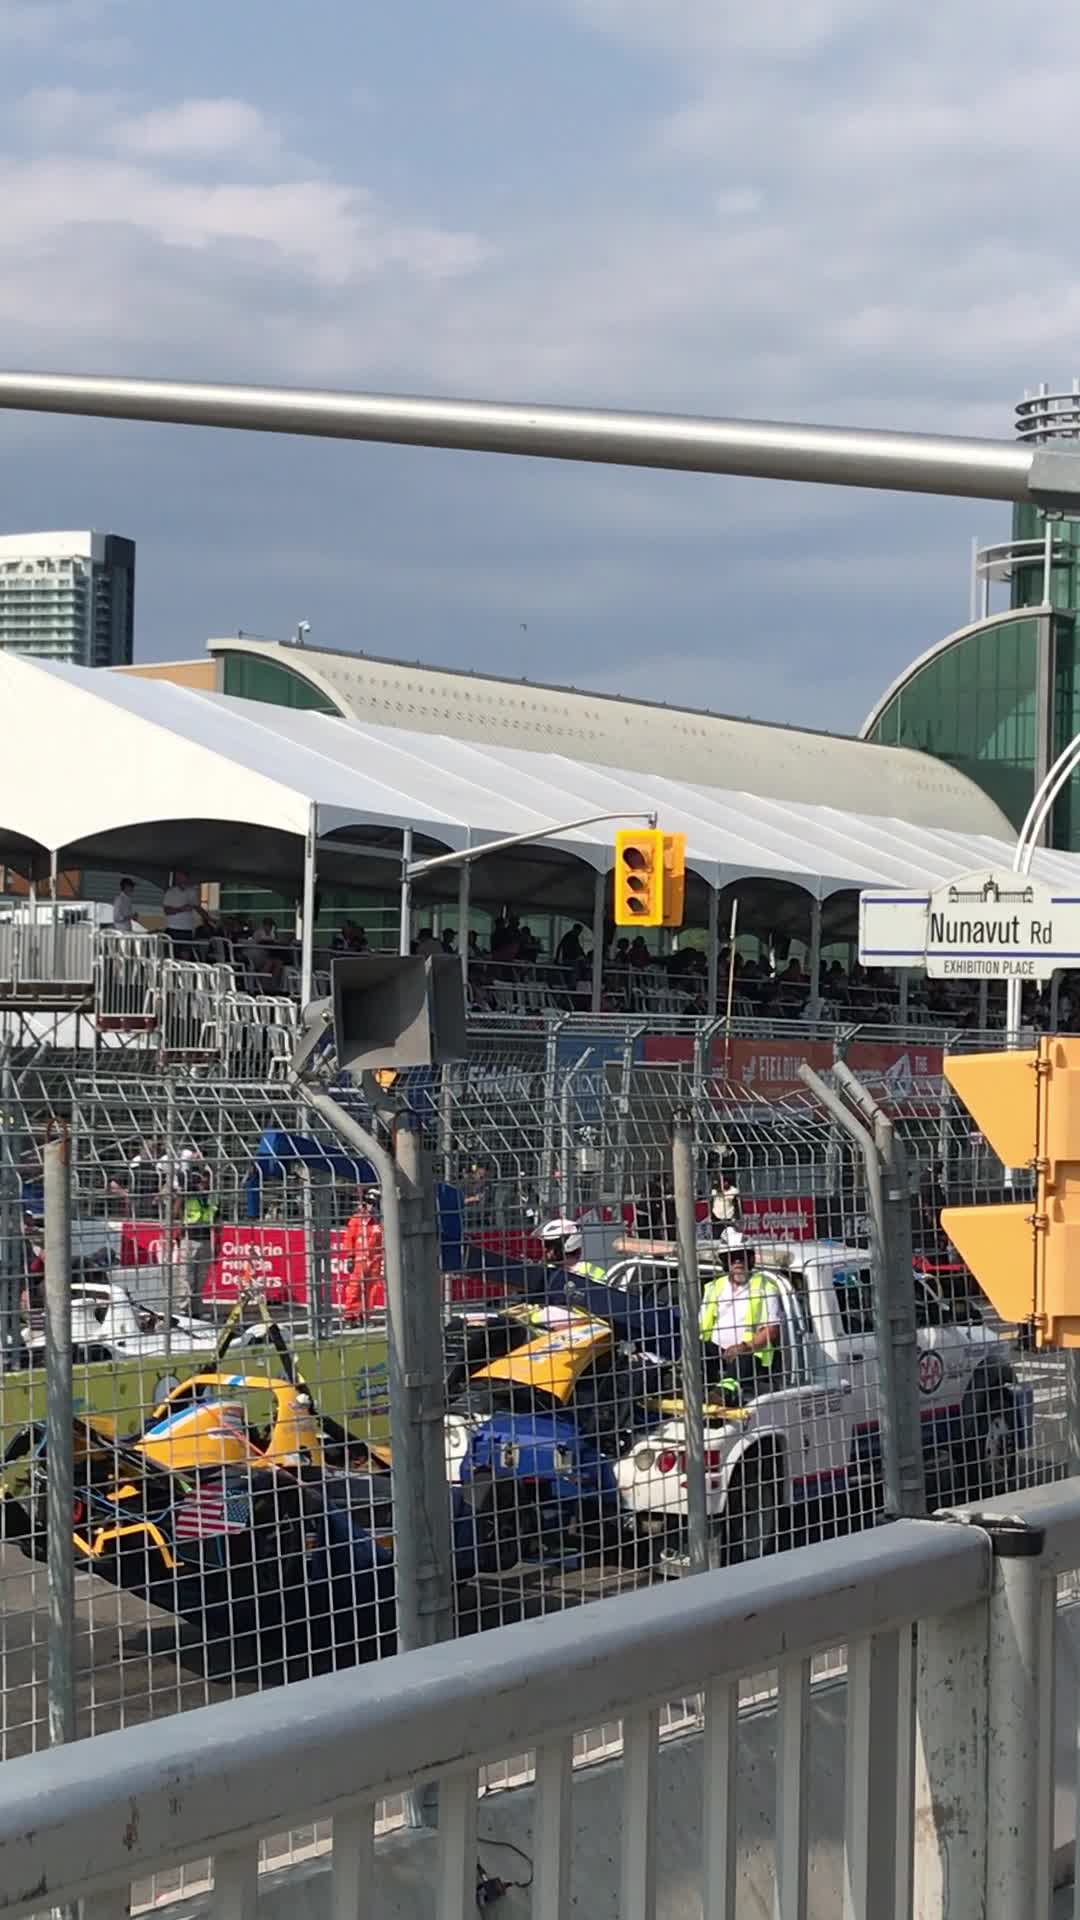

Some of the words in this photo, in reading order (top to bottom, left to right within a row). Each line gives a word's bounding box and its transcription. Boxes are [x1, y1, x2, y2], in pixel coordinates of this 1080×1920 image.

[931, 912, 1020, 945] Nunavut
[1030, 920, 1052, 944] Rd
[943, 960, 1000, 974] EXHIBITION
[1002, 961, 1035, 974] PLACE
[221, 1271, 282, 1289] Deers
